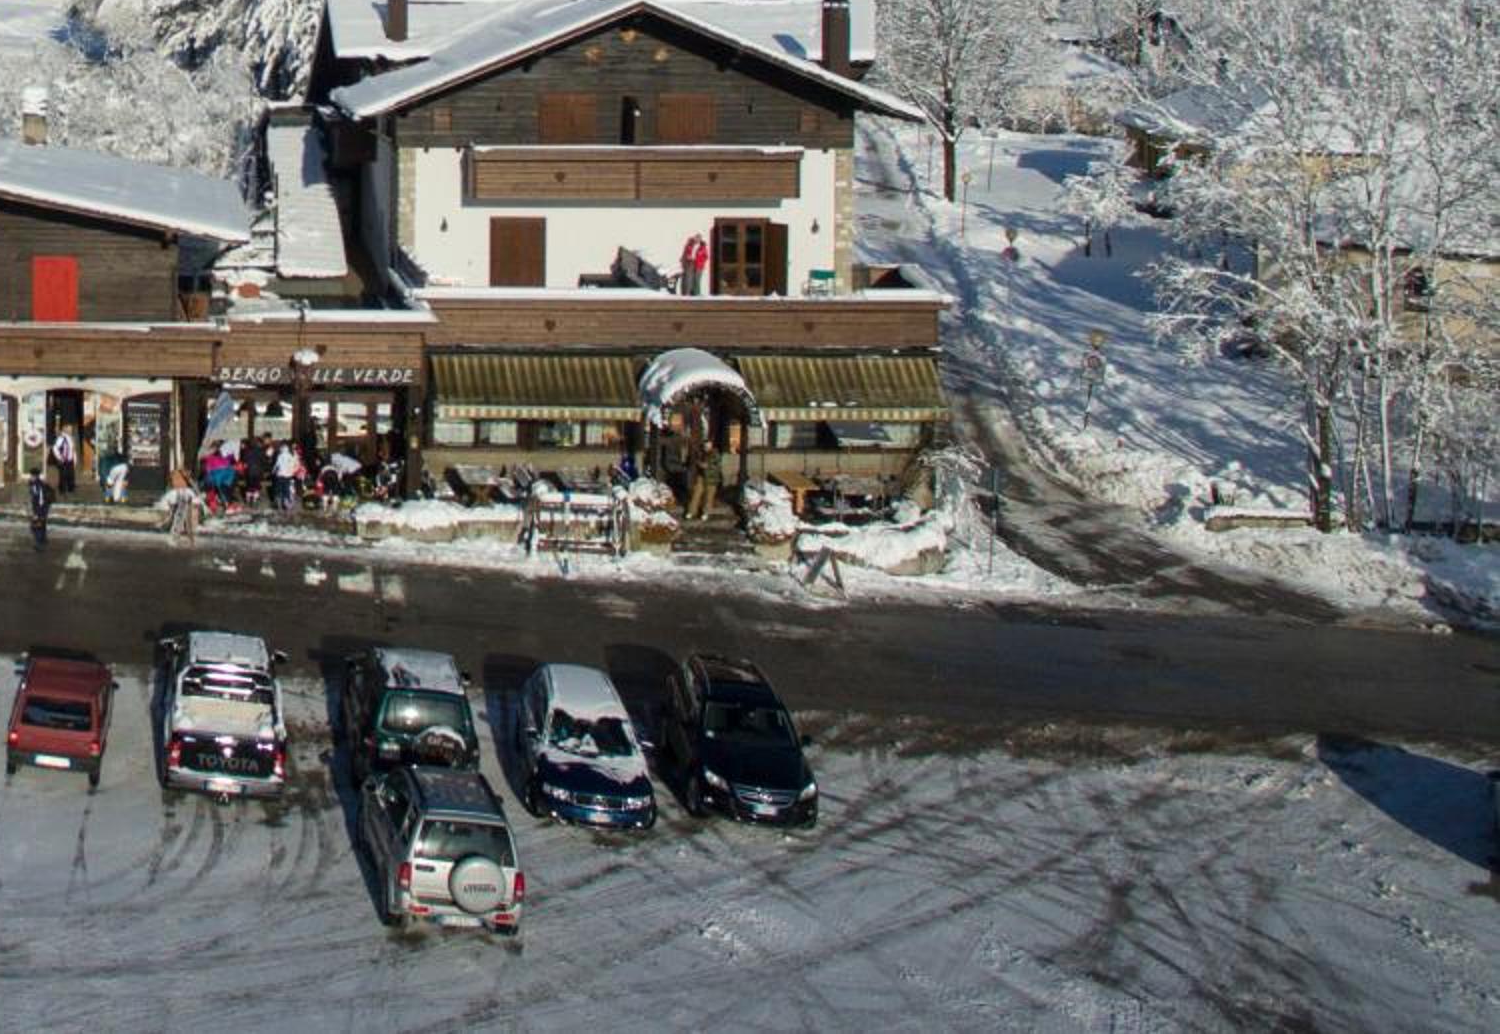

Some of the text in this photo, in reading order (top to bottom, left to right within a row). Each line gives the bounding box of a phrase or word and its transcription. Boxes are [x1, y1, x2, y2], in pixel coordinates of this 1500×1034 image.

[214, 367, 281, 382] BERGO
[353, 368, 414, 384] VERDE
[197, 753, 260, 772] TOYOTA
